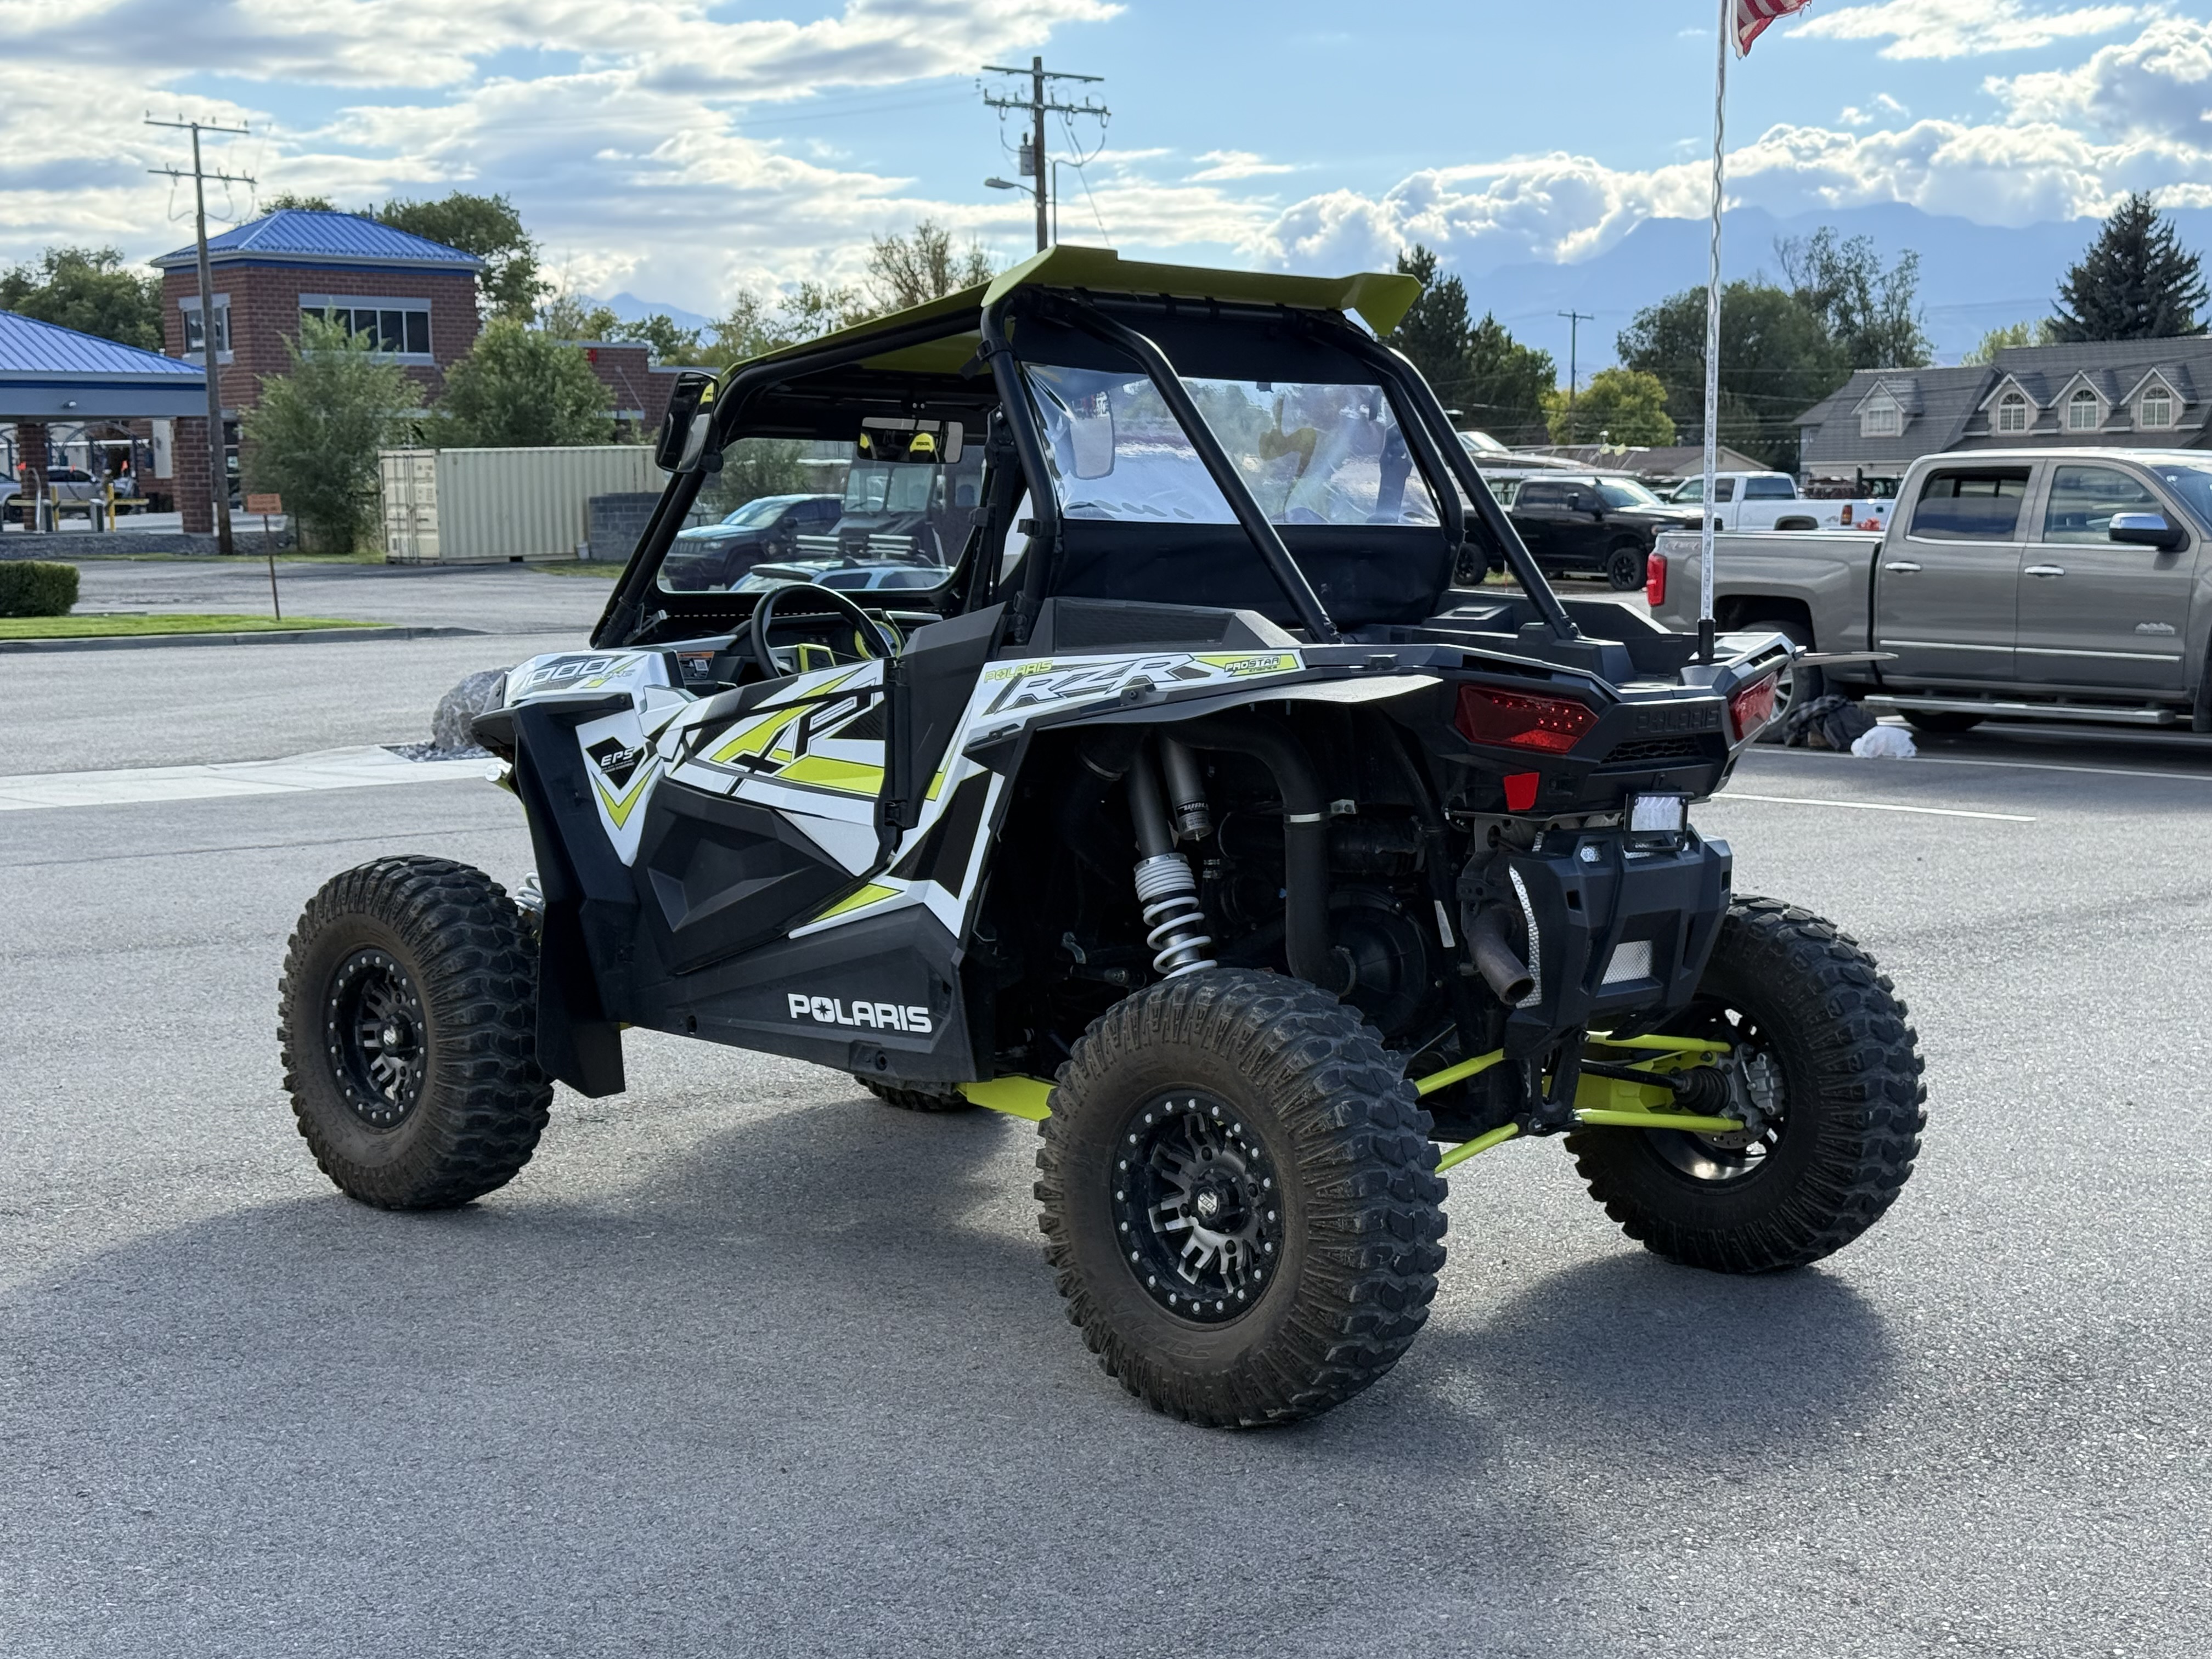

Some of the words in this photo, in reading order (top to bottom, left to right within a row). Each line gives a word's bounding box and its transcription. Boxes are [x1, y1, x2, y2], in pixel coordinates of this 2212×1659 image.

[522, 657, 614, 689] 1000
[984, 659, 1053, 683] POLARIS
[1225, 657, 1280, 672] PROSTAR
[994, 654, 1194, 714] RZR
[1638, 709, 1718, 732] POLARIS
[601, 747, 635, 767] EPS
[787, 993, 933, 1034] POLARIS
